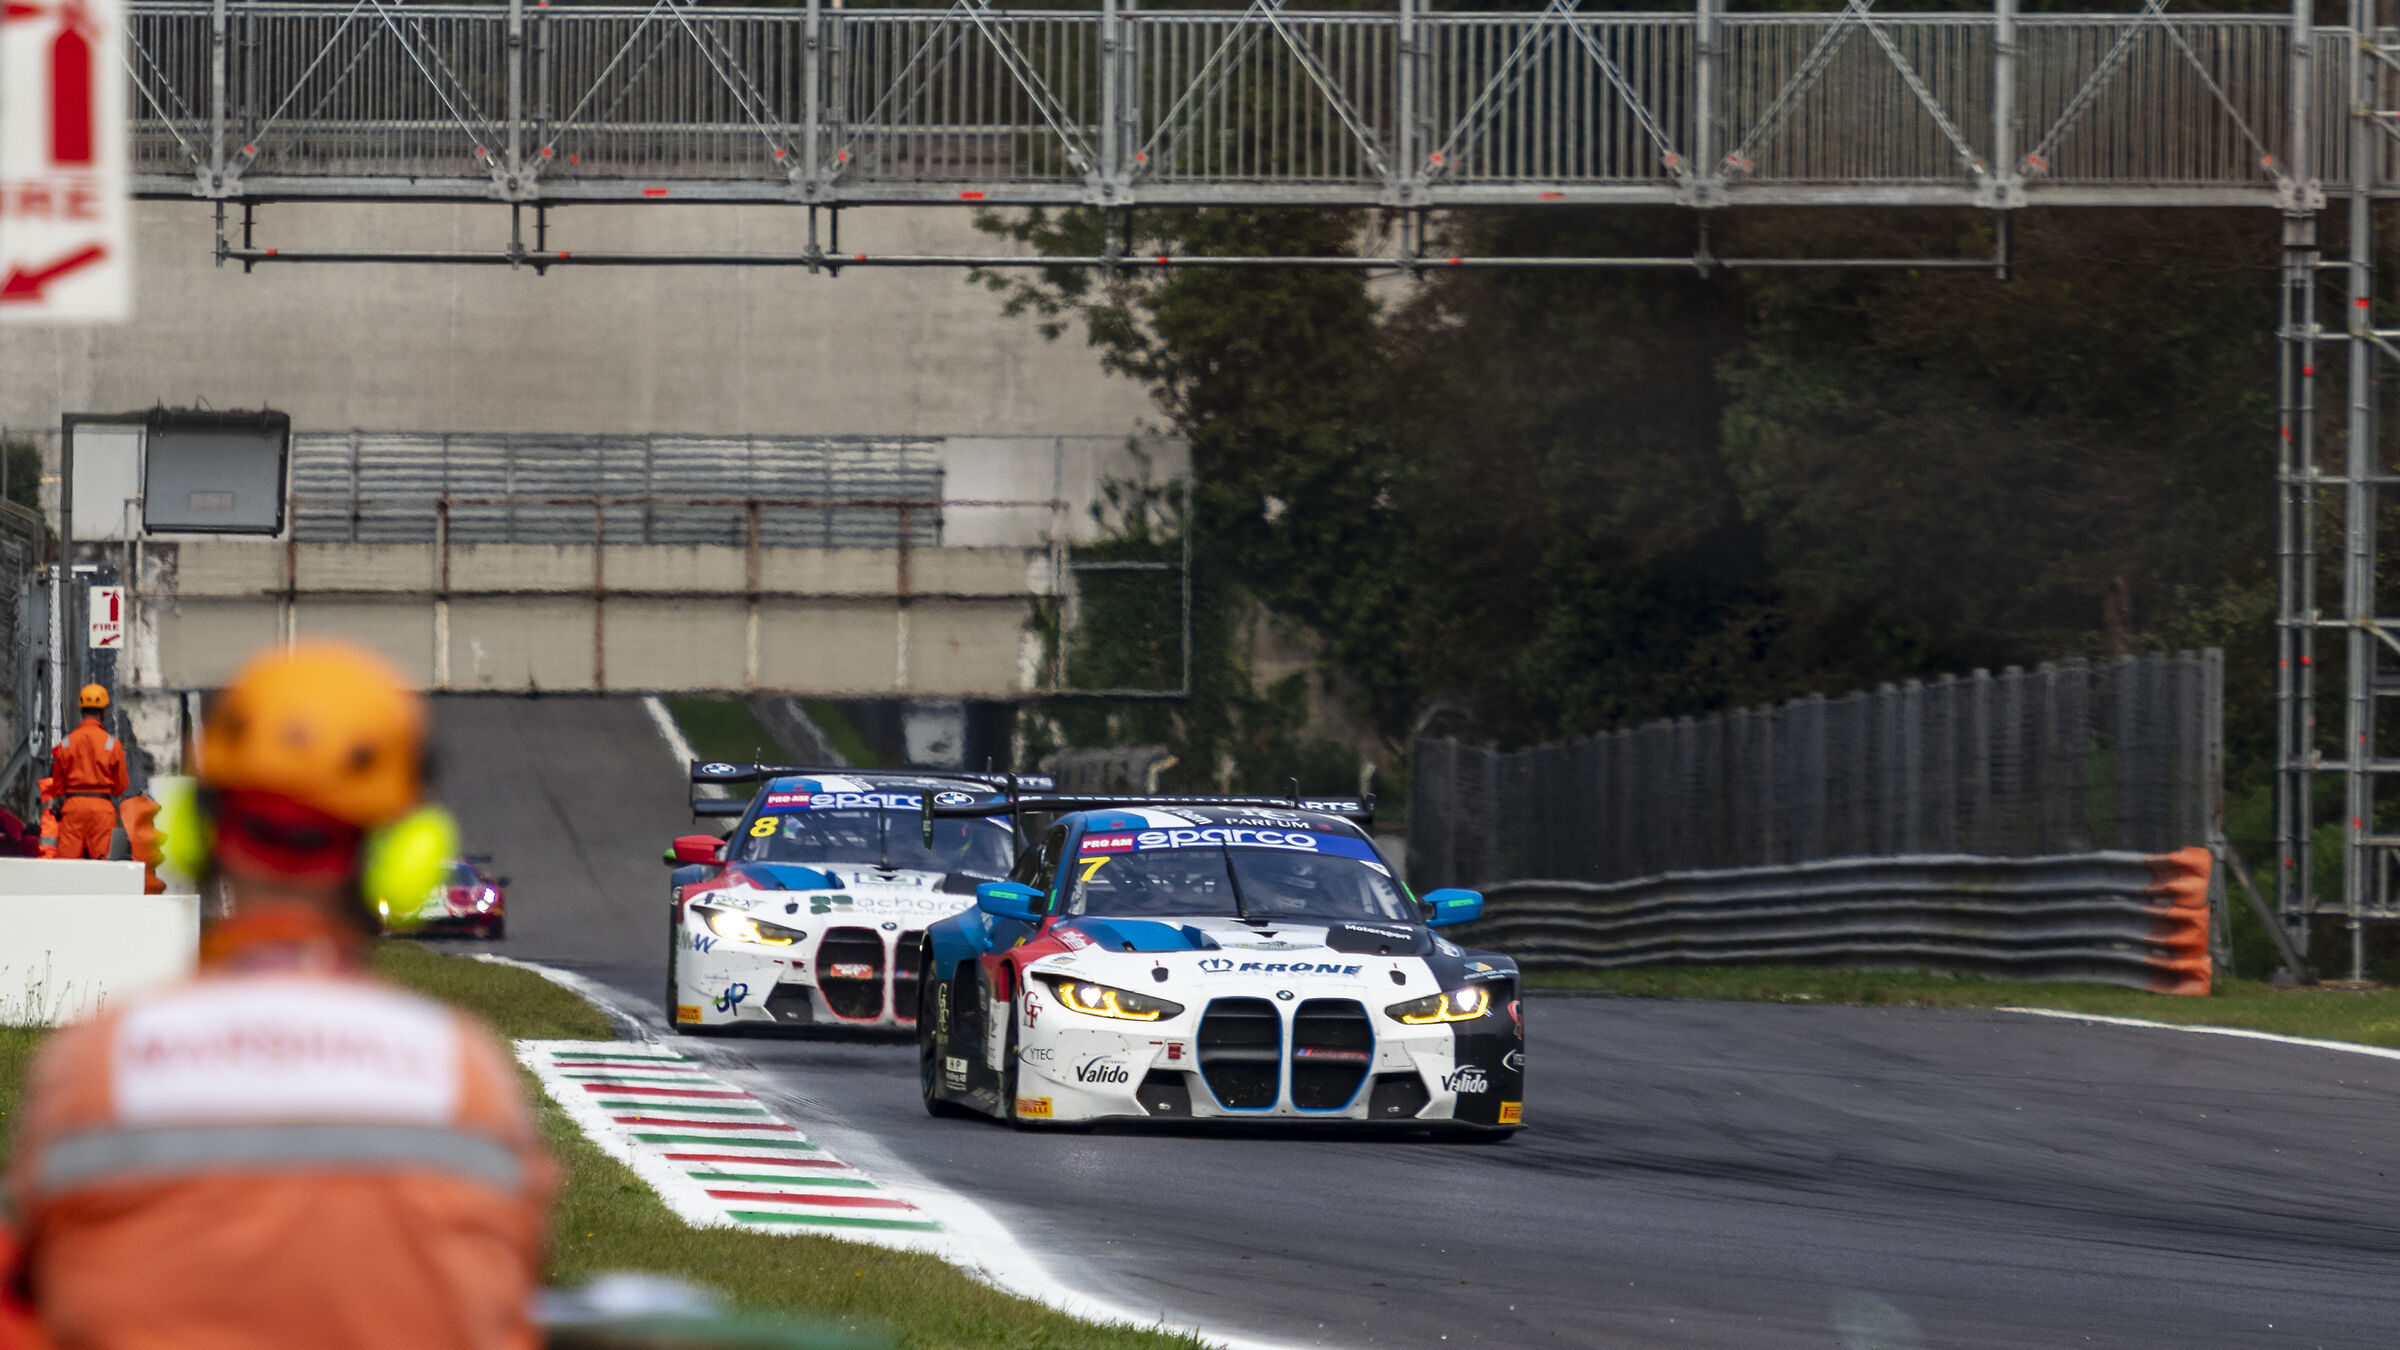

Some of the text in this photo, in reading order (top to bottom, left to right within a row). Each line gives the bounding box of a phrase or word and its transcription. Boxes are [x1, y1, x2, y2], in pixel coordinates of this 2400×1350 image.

[92, 623, 118, 631] FIRE
[749, 817, 779, 838] 8
[1226, 818, 1312, 829] PARFUM
[1082, 837, 1133, 849] PRO AM
[1137, 829, 1318, 849] sparco
[1079, 857, 1111, 881] 7
[1344, 924, 1412, 940] Motorsport
[1239, 962, 1363, 975] KRONE
[1076, 1061, 1129, 1083] Valido
[1441, 1069, 1489, 1093] Valido
